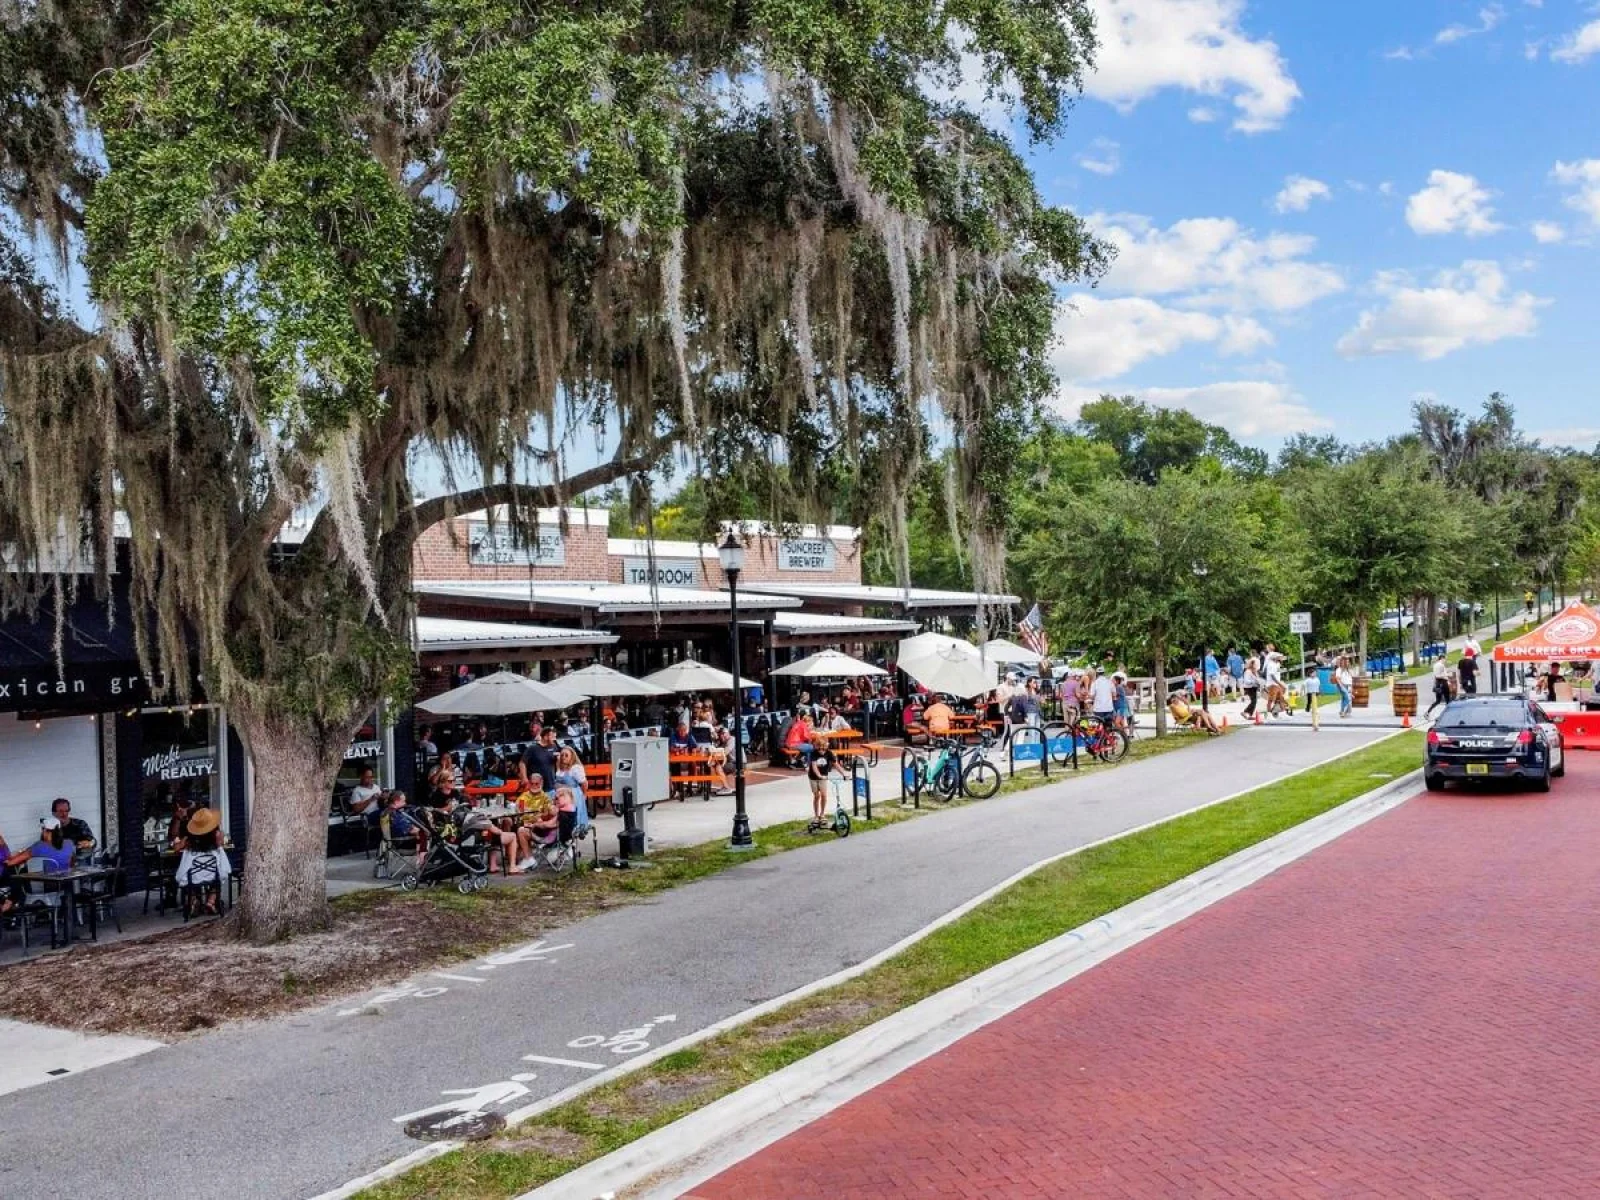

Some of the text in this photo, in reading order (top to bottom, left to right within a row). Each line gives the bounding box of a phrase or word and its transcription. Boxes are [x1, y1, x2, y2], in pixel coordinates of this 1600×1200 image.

[788, 555, 825, 568] BREWERY
[1504, 646, 1565, 657] SUNCREEK
[1459, 740, 1494, 748] POLICE
[142, 743, 180, 777] Micki
[160, 763, 213, 781] REALTY
